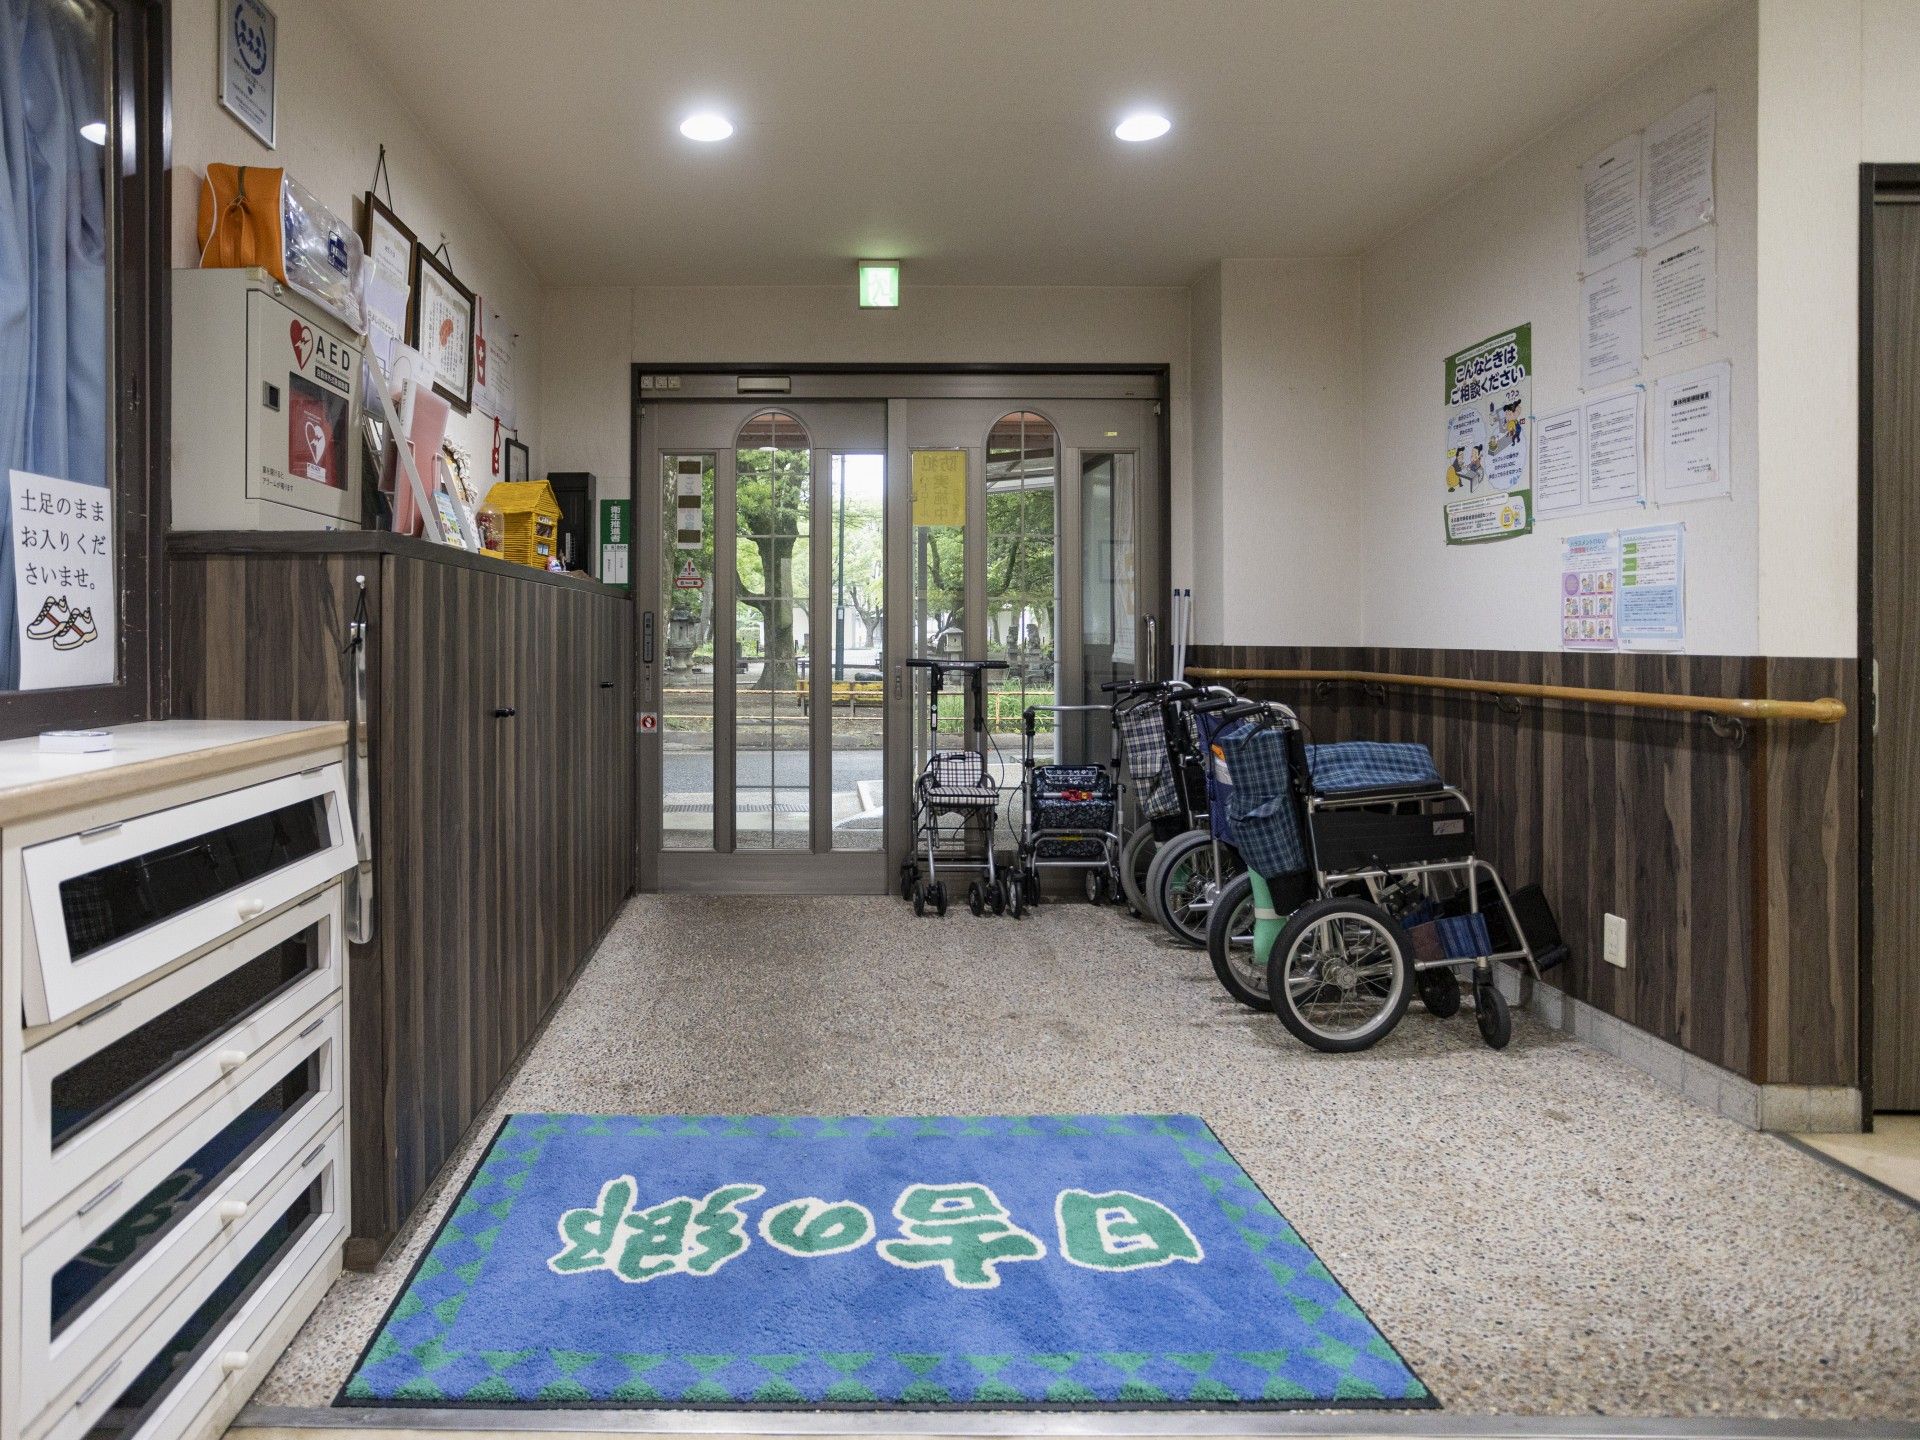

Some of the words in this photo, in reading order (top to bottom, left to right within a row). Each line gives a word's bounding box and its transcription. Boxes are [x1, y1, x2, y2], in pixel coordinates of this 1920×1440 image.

[315, 335, 350, 371] AED
[1456, 345, 1516, 384] こんなときは
[1451, 366, 1524, 405] ご相談ください
[20, 488, 105, 522] 土足のまま
[21, 525, 107, 555] お入りくだ
[25, 562, 96, 590] さいませ。
